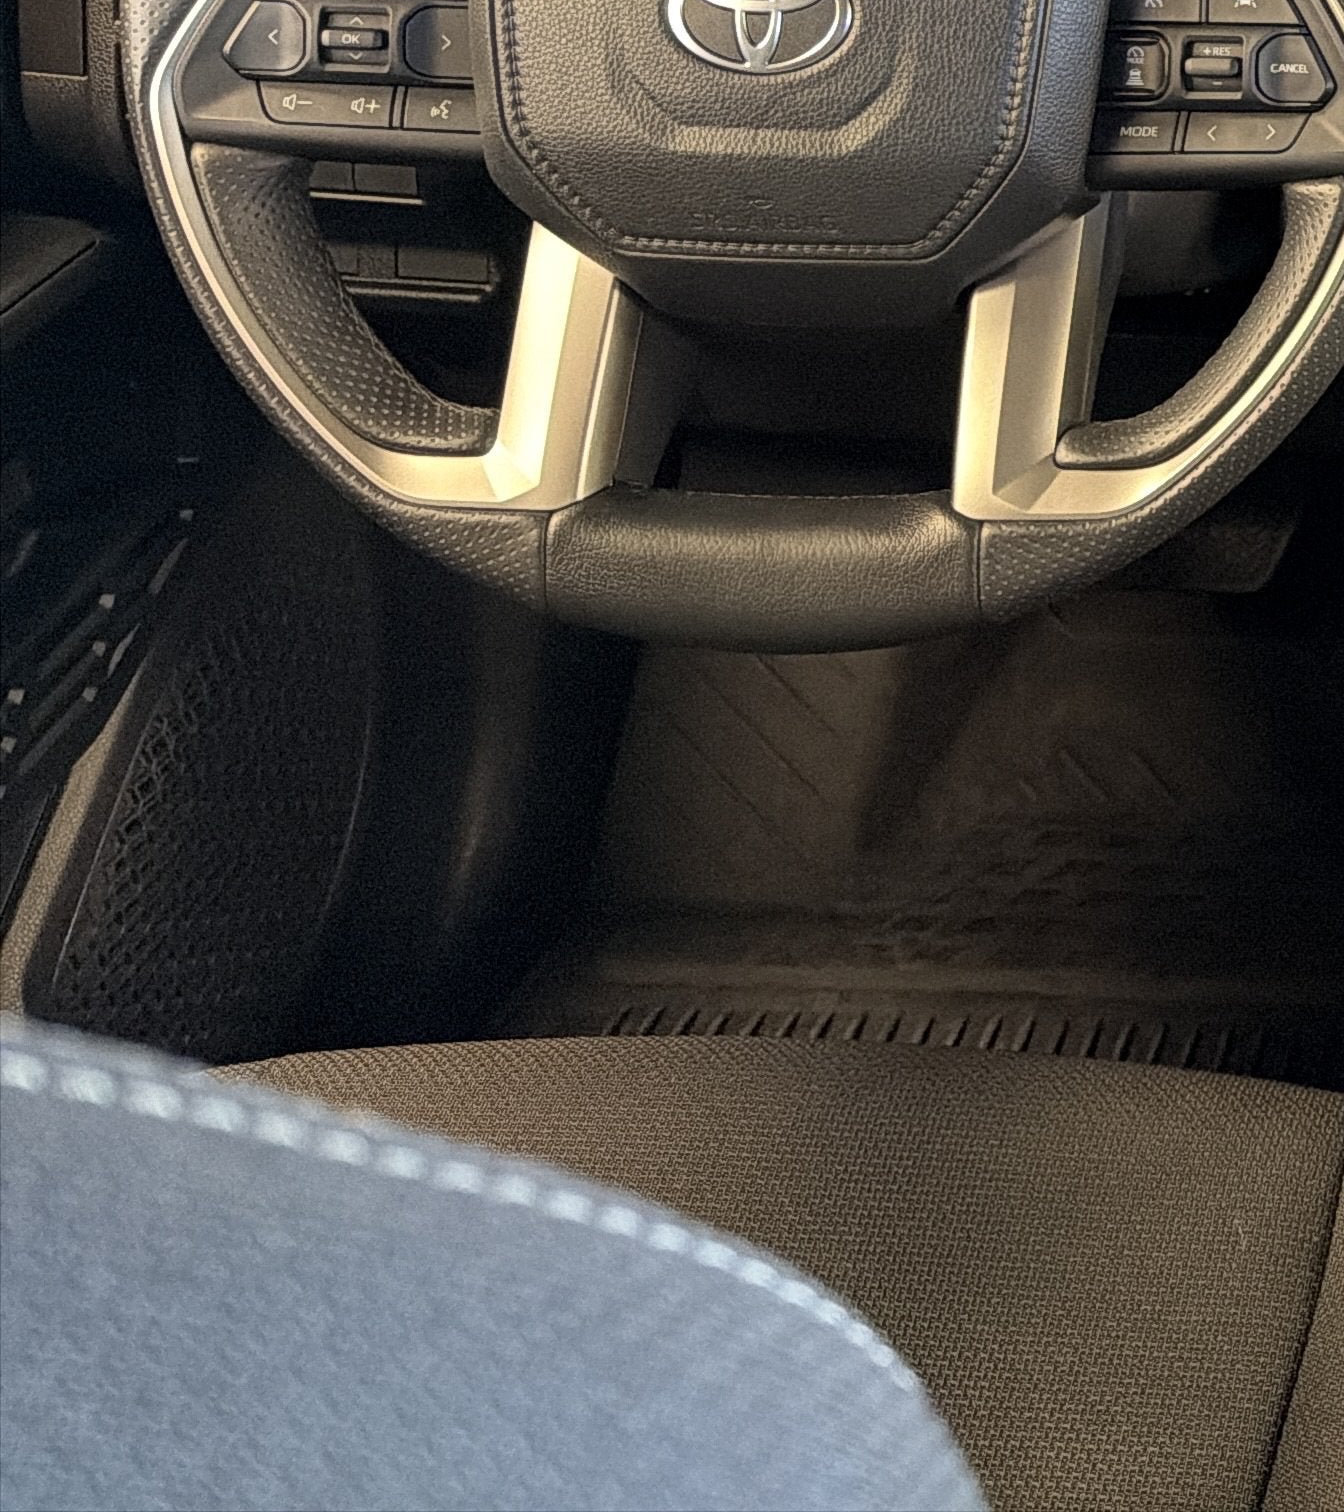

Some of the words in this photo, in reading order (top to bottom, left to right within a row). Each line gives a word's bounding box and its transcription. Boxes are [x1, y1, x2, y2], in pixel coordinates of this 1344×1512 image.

[341, 33, 360, 45] OK
[1270, 63, 1310, 75] CANCEL
[1120, 125, 1159, 138] MODE
